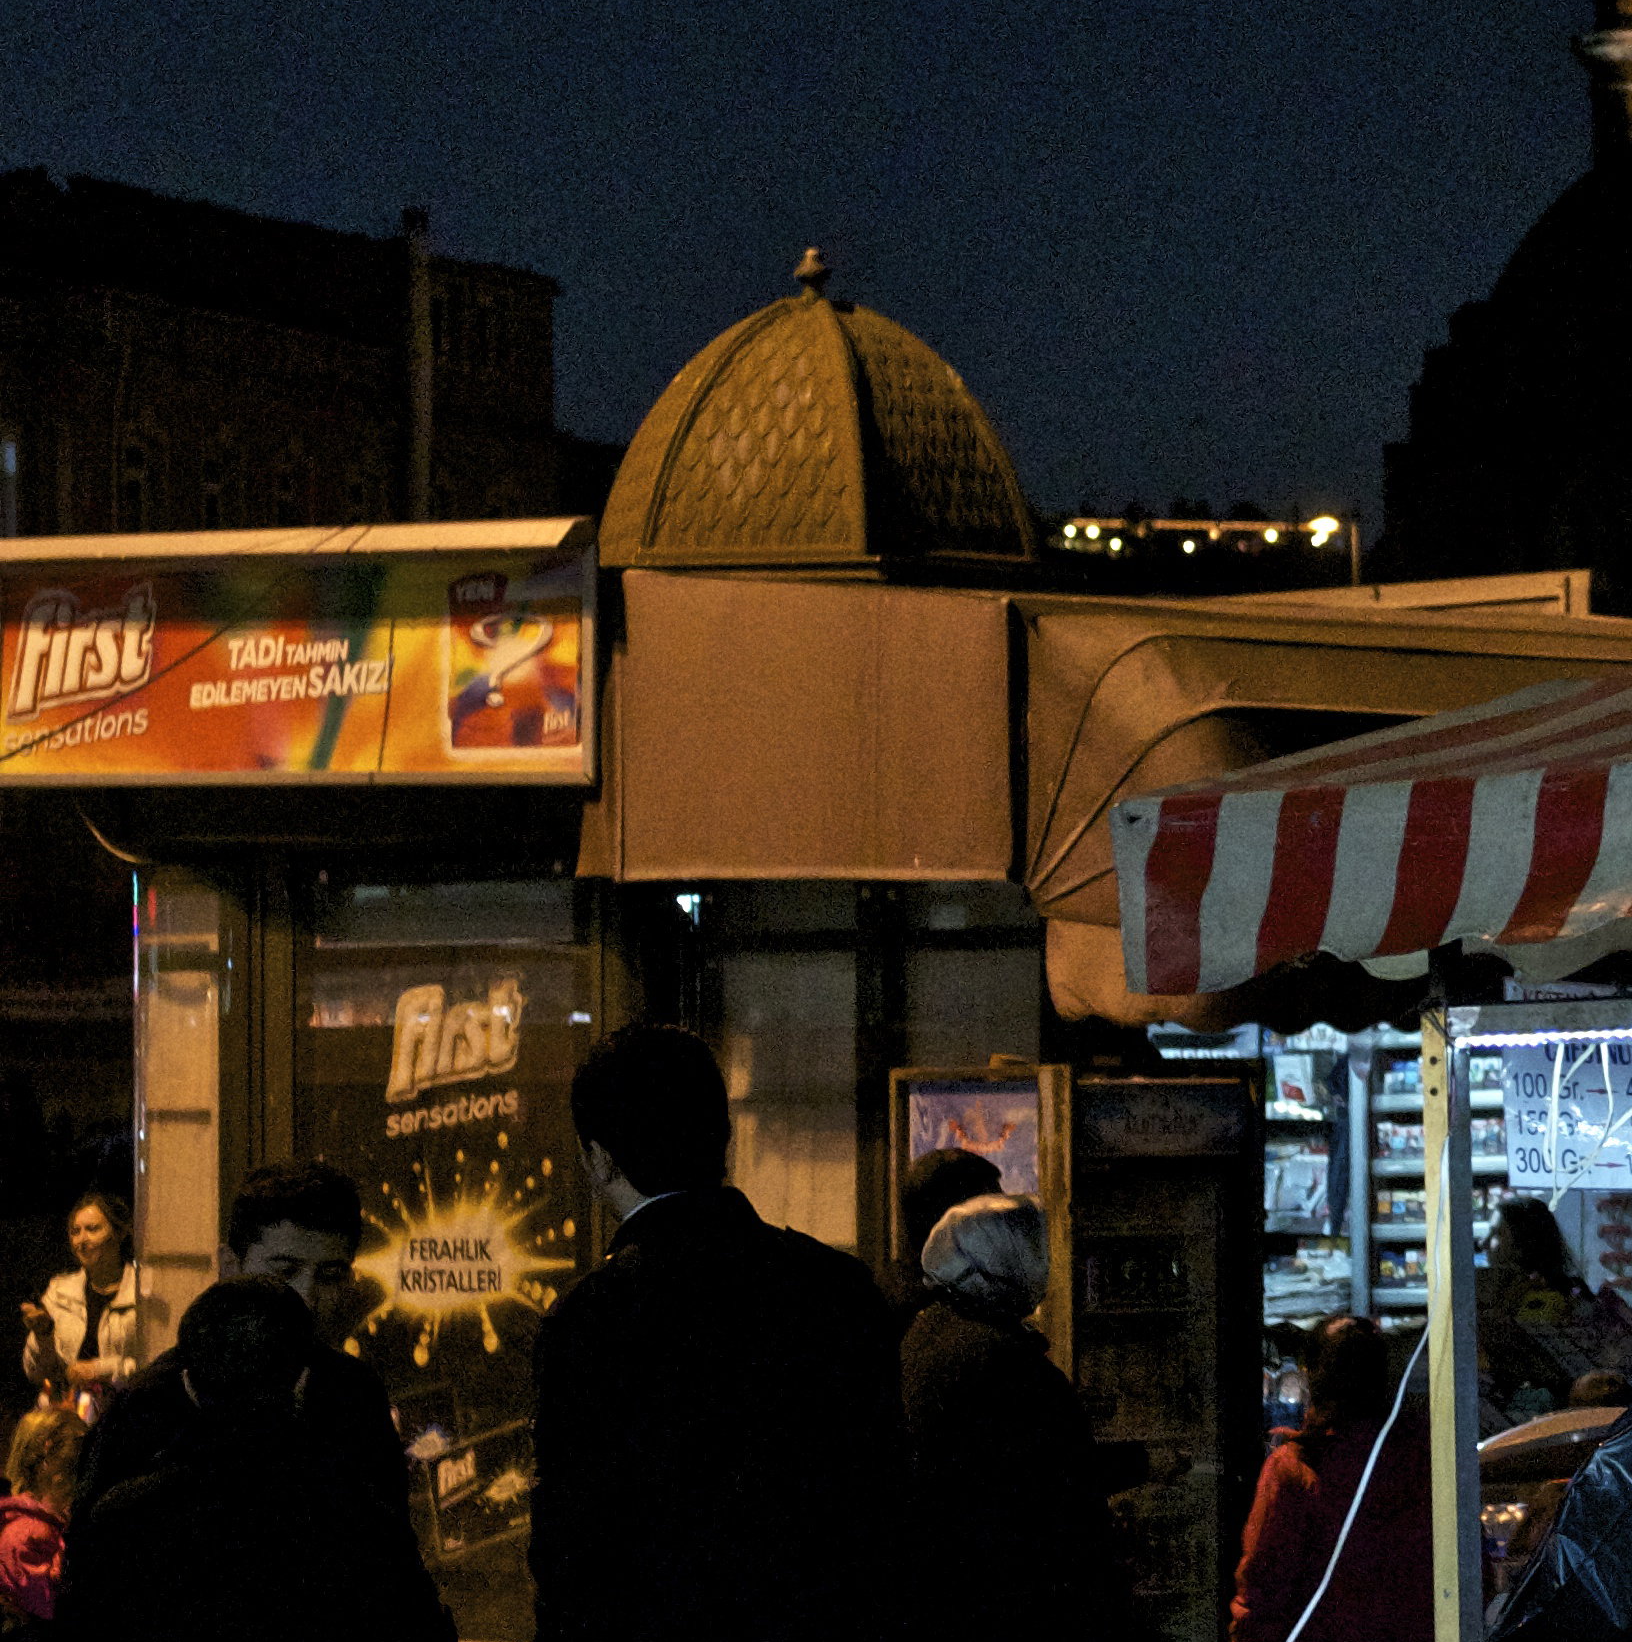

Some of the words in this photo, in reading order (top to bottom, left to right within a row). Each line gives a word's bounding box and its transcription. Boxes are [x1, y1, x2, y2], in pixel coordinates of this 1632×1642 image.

[7, 583, 157, 724] first
[228, 635, 285, 671] TADI
[4, 708, 149, 755] sensations
[386, 979, 523, 1103] first
[1513, 1072, 1548, 1099] 100
[386, 1090, 518, 1139] sensations
[409, 1238, 492, 1261] FERAHLIK
